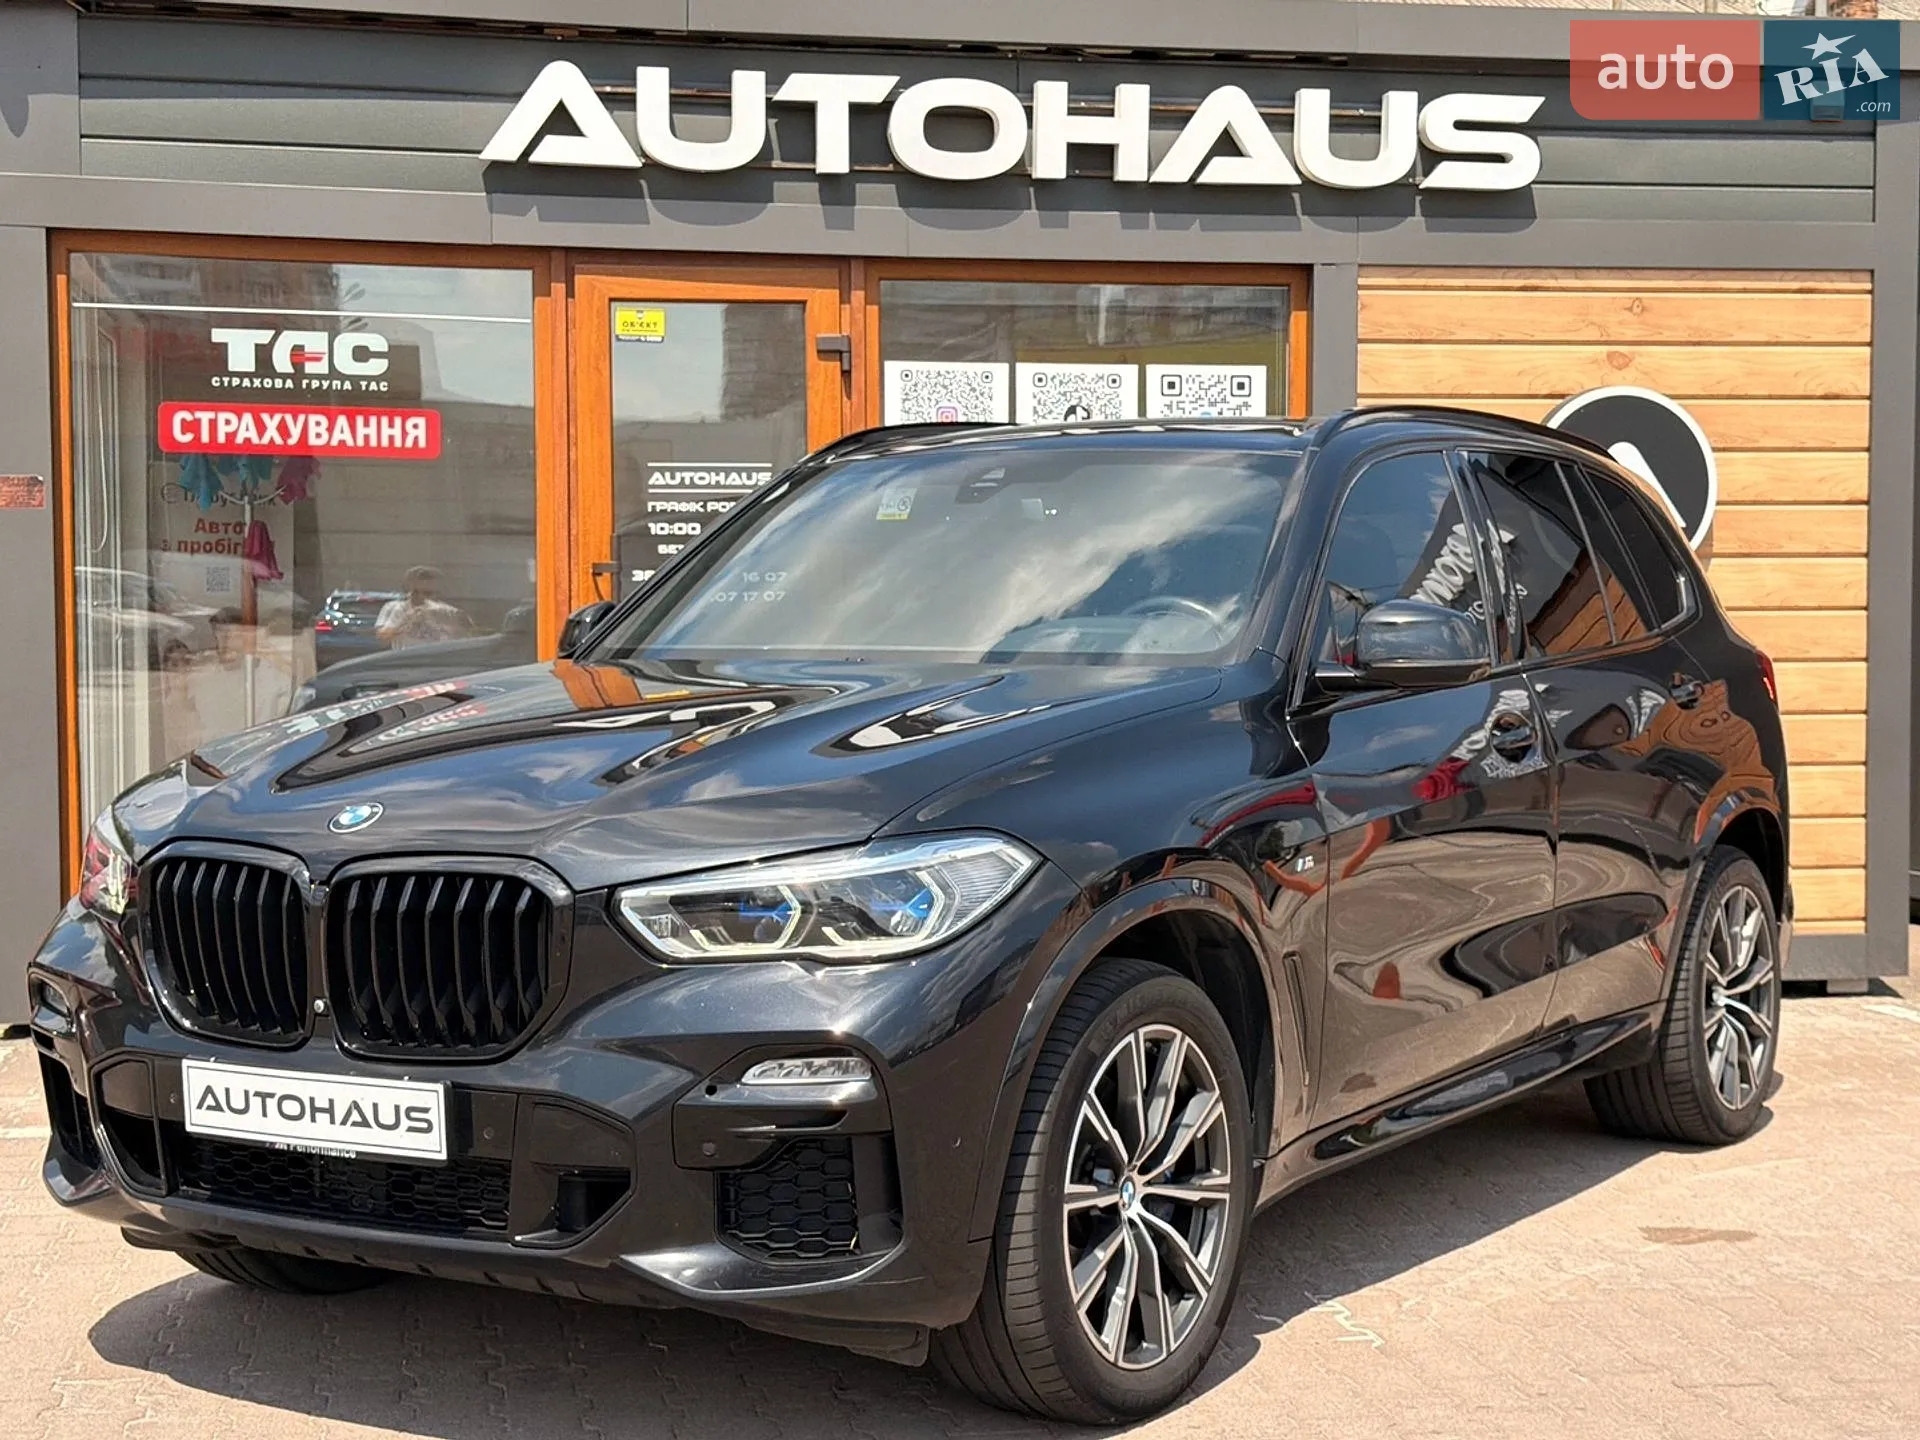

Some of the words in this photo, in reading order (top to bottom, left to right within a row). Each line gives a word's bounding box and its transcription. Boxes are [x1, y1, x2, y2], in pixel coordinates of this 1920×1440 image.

[479, 60, 1543, 192] AUTOHAUS
[211, 376, 294, 389] СТРАХОВА
[301, 379, 352, 391] ГРУПА
[359, 380, 390, 392] ТАС
[172, 410, 427, 449] СТРАХУВАННЯ
[648, 471, 773, 486] AUTOHAUS
[647, 501, 705, 513] ГРАФІК
[194, 517, 245, 535] Авто
[647, 522, 702, 535] 10:00
[196, 1084, 434, 1134] AUTOHAUS
